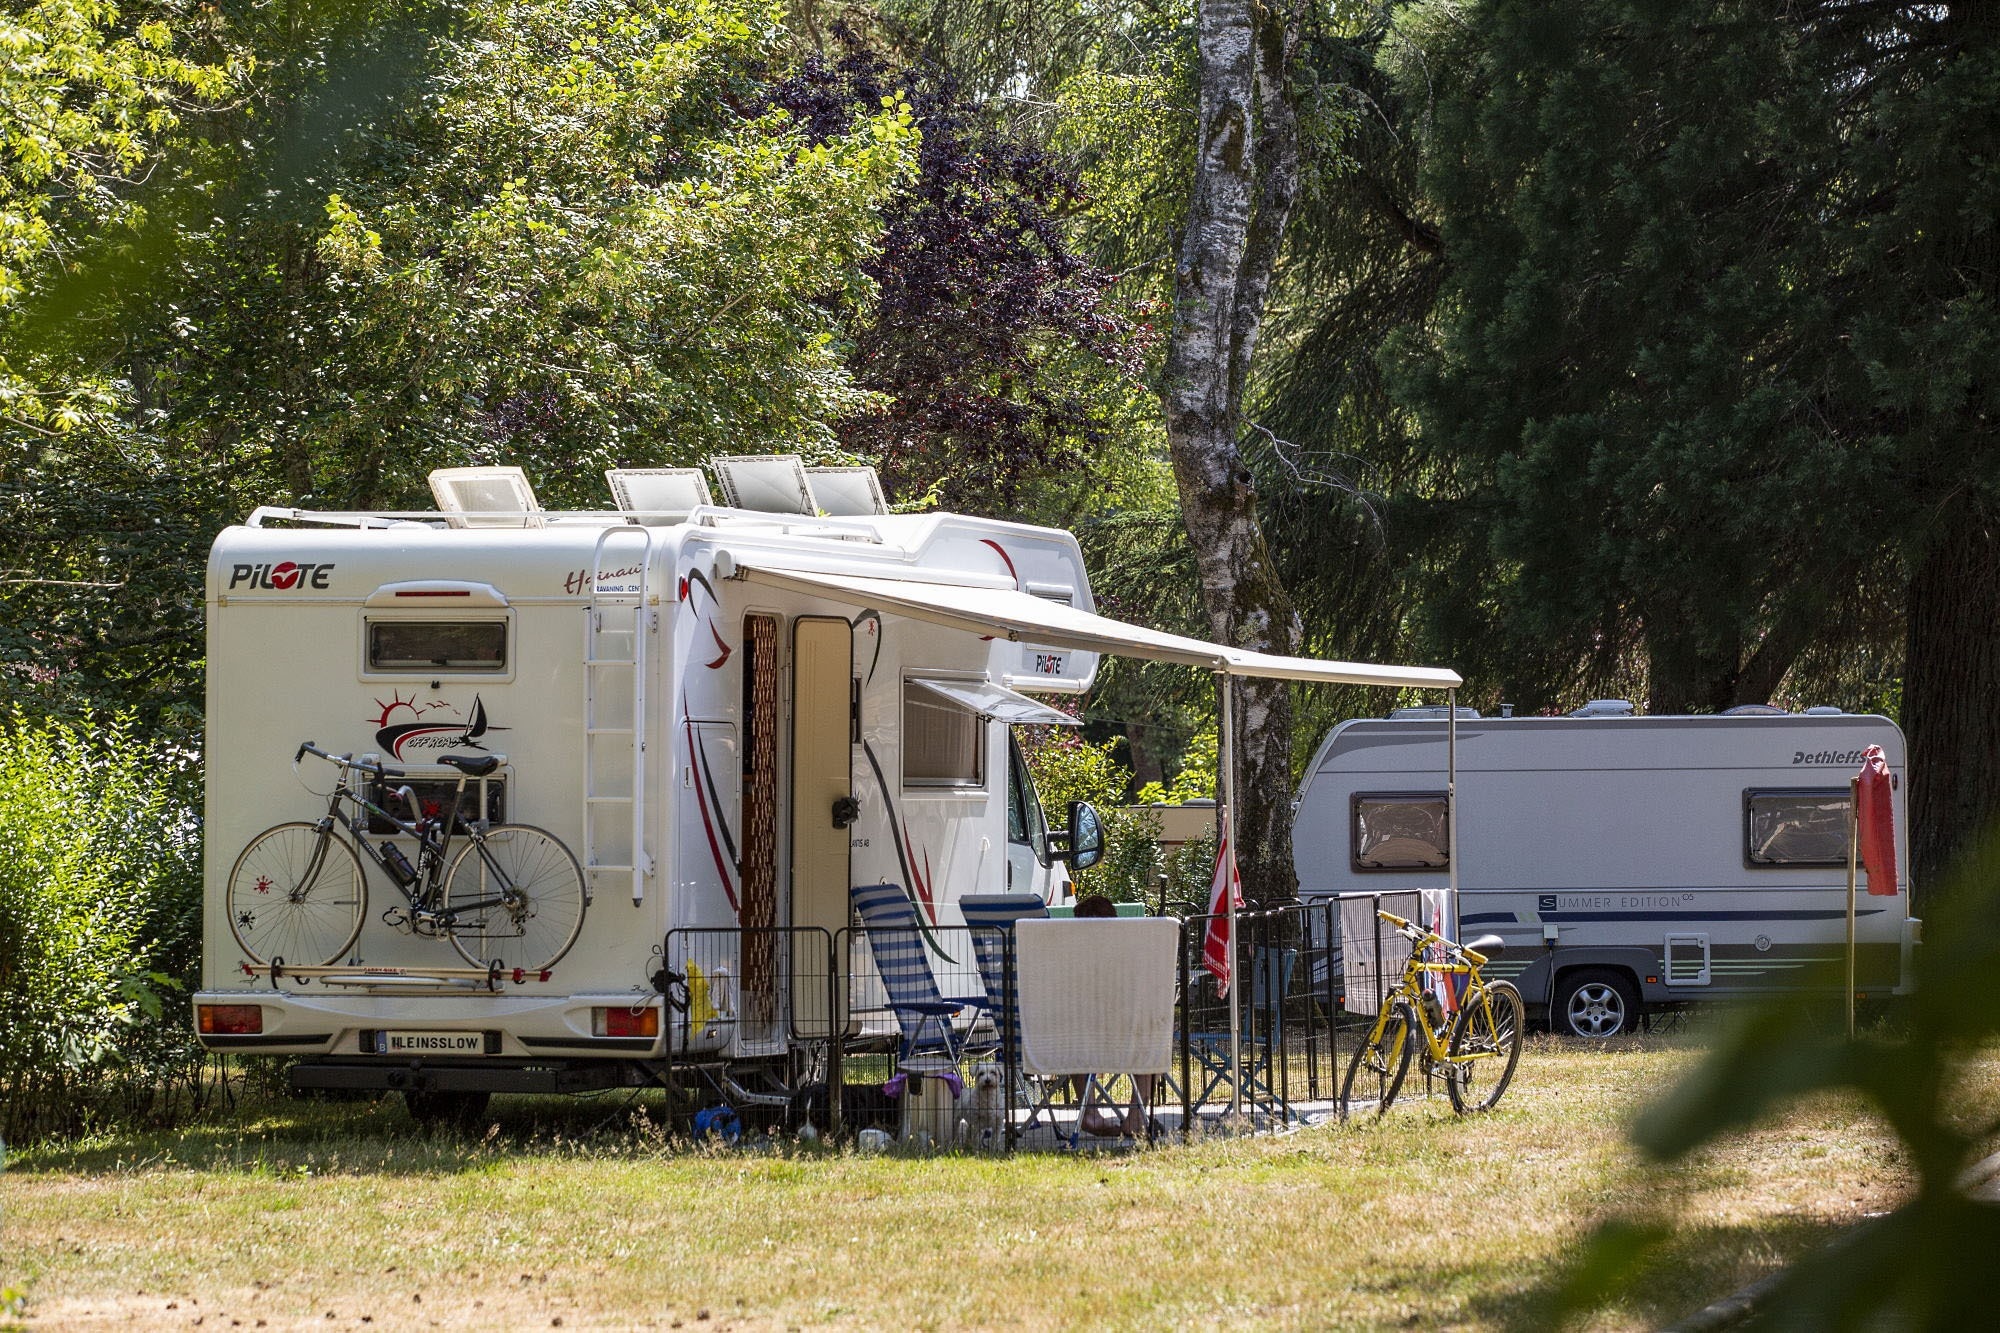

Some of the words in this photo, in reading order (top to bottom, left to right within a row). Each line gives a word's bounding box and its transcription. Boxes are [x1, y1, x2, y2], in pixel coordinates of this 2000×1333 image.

[407, 737, 430, 747] OFF
[1792, 750, 1866, 764] Dethleffs
[1539, 896, 1611, 910] SUMMER
[1621, 896, 1680, 908] EDITION
[379, 1044, 386, 1052] B
